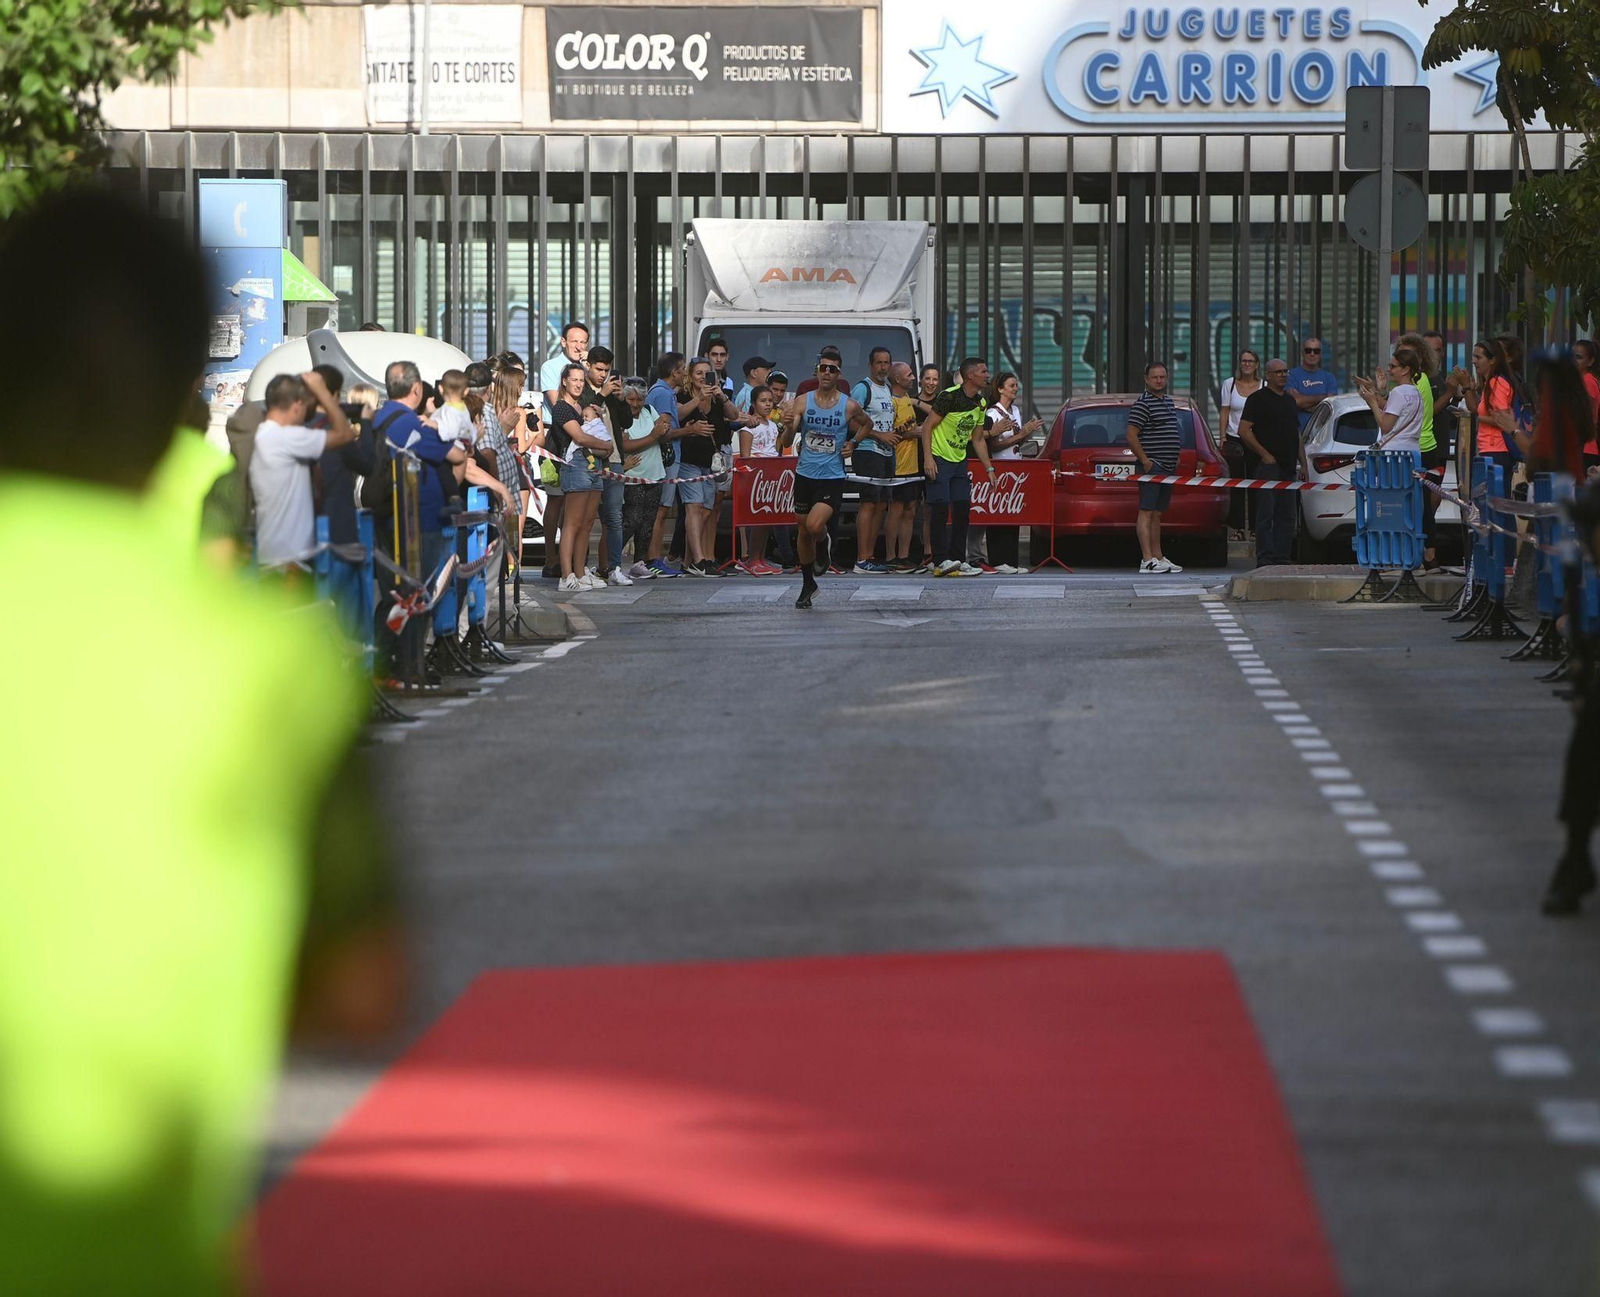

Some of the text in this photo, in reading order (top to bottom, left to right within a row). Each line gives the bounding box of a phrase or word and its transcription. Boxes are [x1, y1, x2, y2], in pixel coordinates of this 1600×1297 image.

[1118, 6, 1352, 40] JUGUETES
[555, 30, 676, 71] COLOR
[723, 45, 806, 61] PRODUCTOS DE
[445, 61, 460, 84] TE
[464, 61, 516, 84] CORTES
[723, 63, 853, 82] PELUQUERÍA Y ESTÉTICA
[1083, 48, 1389, 104] CARRION
[556, 84, 695, 97] MI BOUTIQUE DE BELLEZA
[759, 267, 857, 284] AMA
[807, 415, 841, 427] nerja
[809, 436, 834, 447] 723
